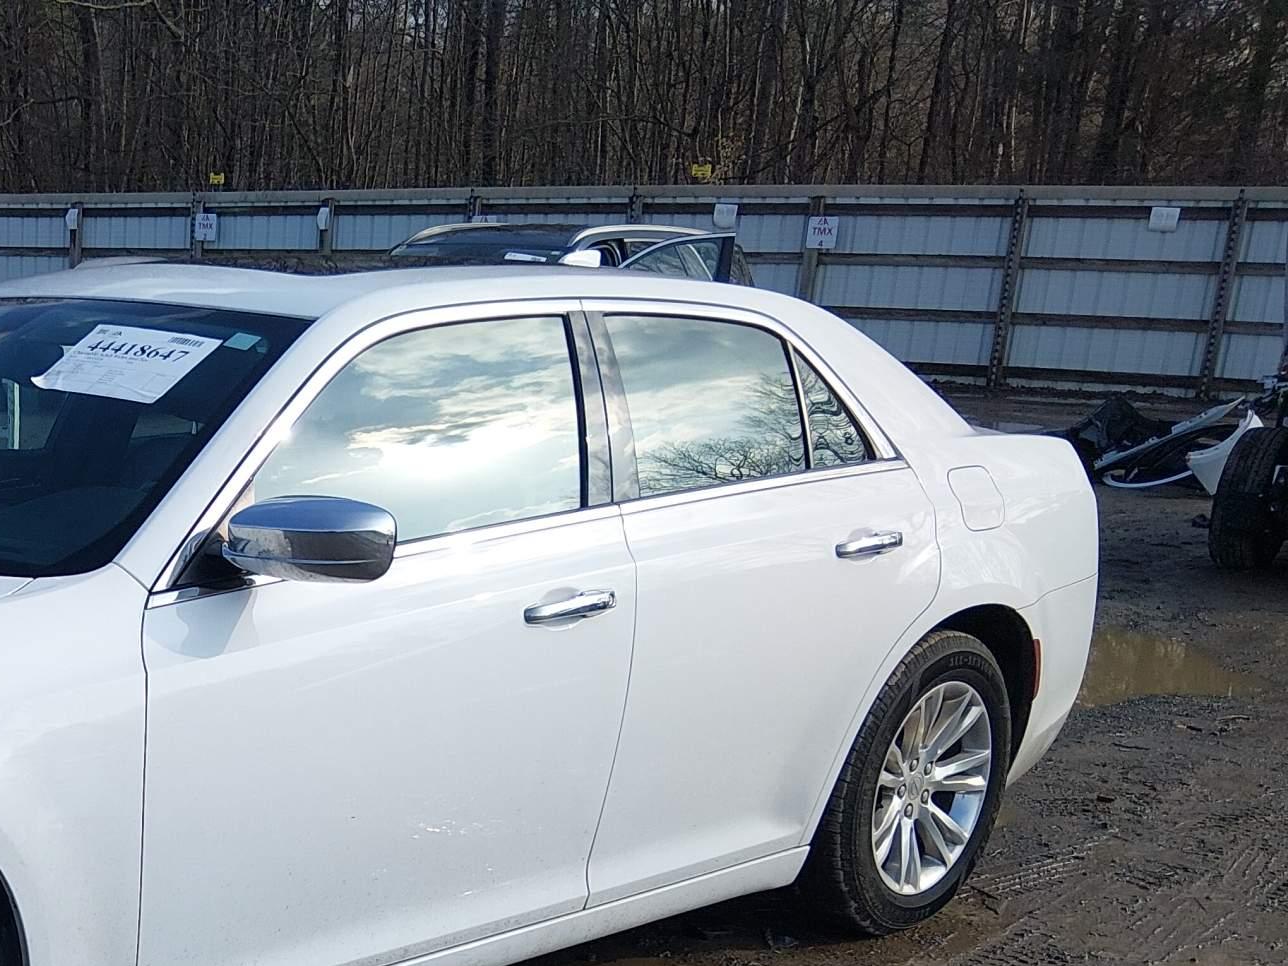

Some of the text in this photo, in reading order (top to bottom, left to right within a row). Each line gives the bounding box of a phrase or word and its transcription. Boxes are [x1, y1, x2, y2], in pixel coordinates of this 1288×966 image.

[198, 222, 213, 230] TMX
[812, 226, 833, 236] TMX
[87, 339, 190, 362] 44418647
